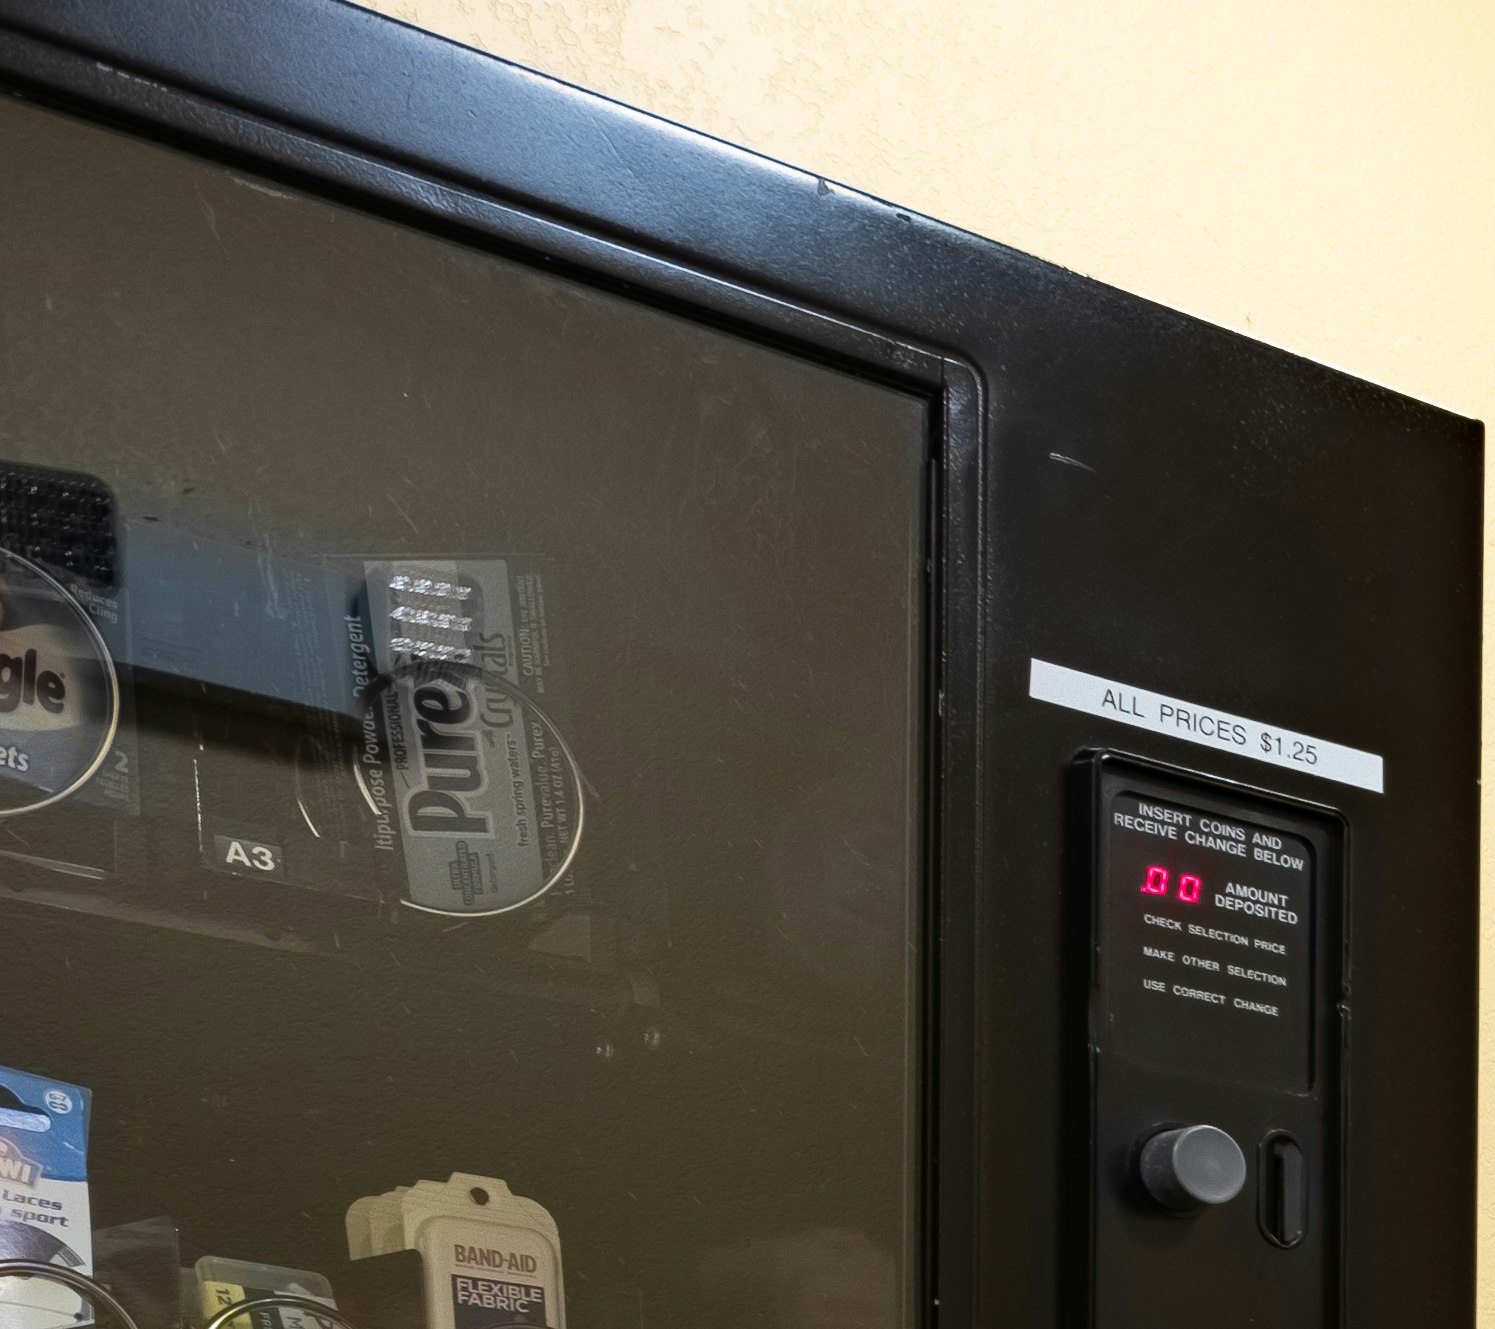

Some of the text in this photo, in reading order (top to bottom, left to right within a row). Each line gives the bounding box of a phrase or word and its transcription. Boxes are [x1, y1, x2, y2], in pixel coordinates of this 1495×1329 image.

[1102, 689, 1318, 765] ALL PRICES $1.25
[1114, 813, 1303, 871] RECEIVE CHANGE BELOW
[1139, 803, 1281, 850] INSERT COINS AND
[225, 840, 275, 871] A3
[1215, 894, 1298, 925] DEPOSITED
[1226, 883, 1288, 907] AMOUNT
[1144, 914, 1287, 955] CHECK SELECTION PRICE
[1143, 946, 1287, 986] MAKE OTHER SELECTION
[1143, 979, 1279, 1016] USE CORRECT CHANGE
[2, 1189, 63, 1211] Laces
[10, 1208, 70, 1229] sport
[454, 1244, 538, 1274] BAND-AID
[456, 1278, 543, 1303] FLEXIBLE
[457, 1292, 530, 1313] FABRIC
